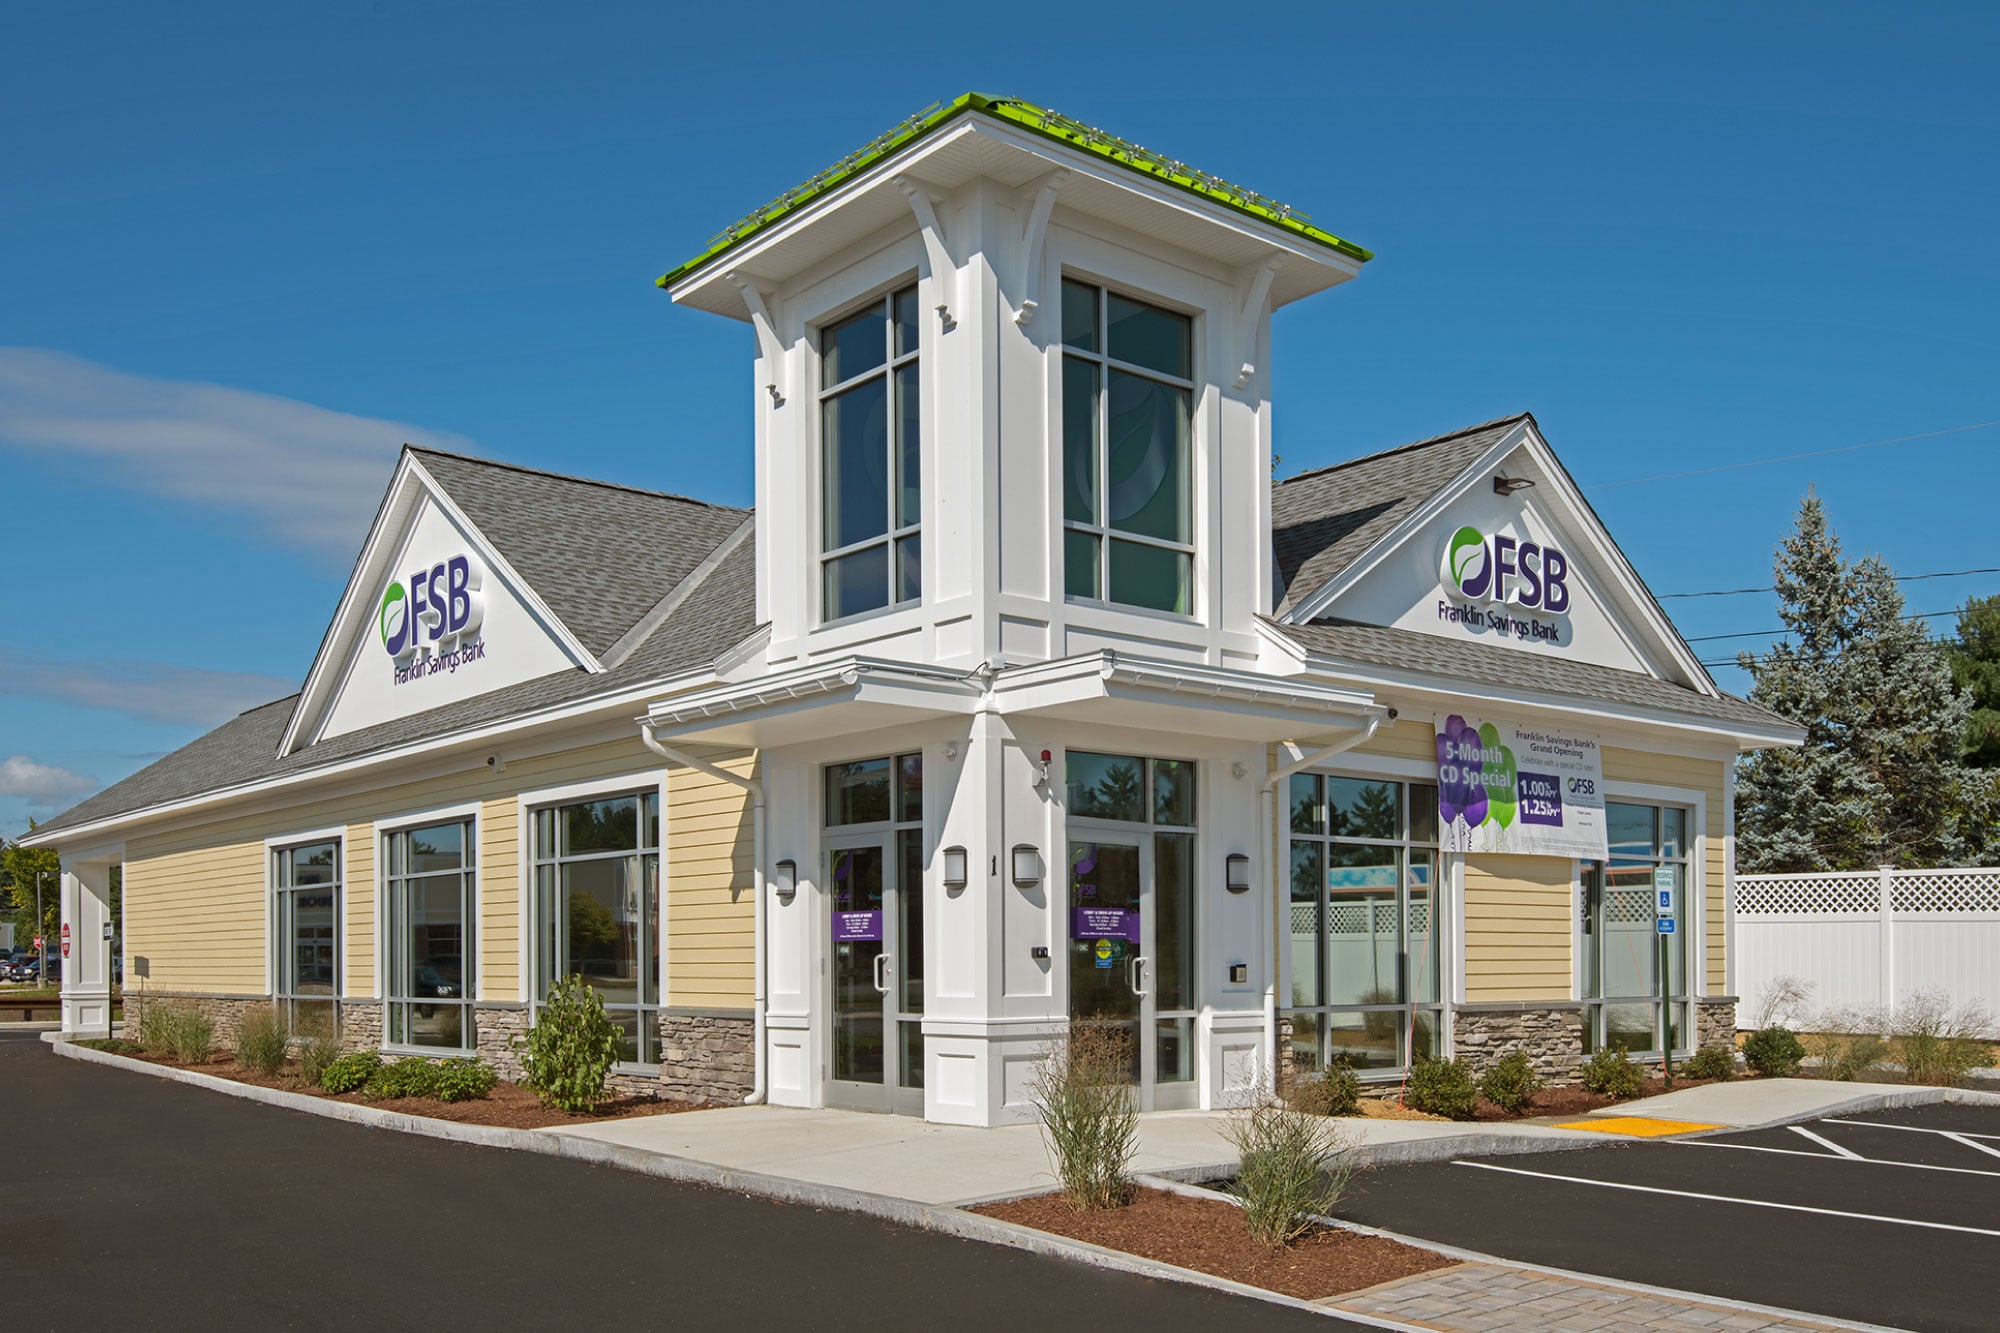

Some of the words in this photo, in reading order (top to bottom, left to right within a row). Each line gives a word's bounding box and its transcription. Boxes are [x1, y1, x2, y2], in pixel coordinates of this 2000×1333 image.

[1494, 534, 1570, 613] FSB
[410, 555, 471, 647] FSB
[1438, 601, 1484, 627] Franklin
[1488, 611, 1530, 640] Savings
[1532, 620, 1560, 642] Bank
[394, 658, 426, 686] Franklin
[427, 649, 461, 674] Savings
[462, 637, 486, 665] Bank
[1446, 741, 1503, 764] 5-Month
[1516, 730, 1545, 742] Franklin
[1546, 735, 1572, 748] Savings
[1574, 739, 1596, 750] Bank's
[1530, 743, 1552, 754] Grand
[1554, 746, 1584, 760] Opening
[1440, 765, 1459, 784] CD
[1462, 767, 1511, 790] Special
[1576, 778, 1595, 795] FSB
